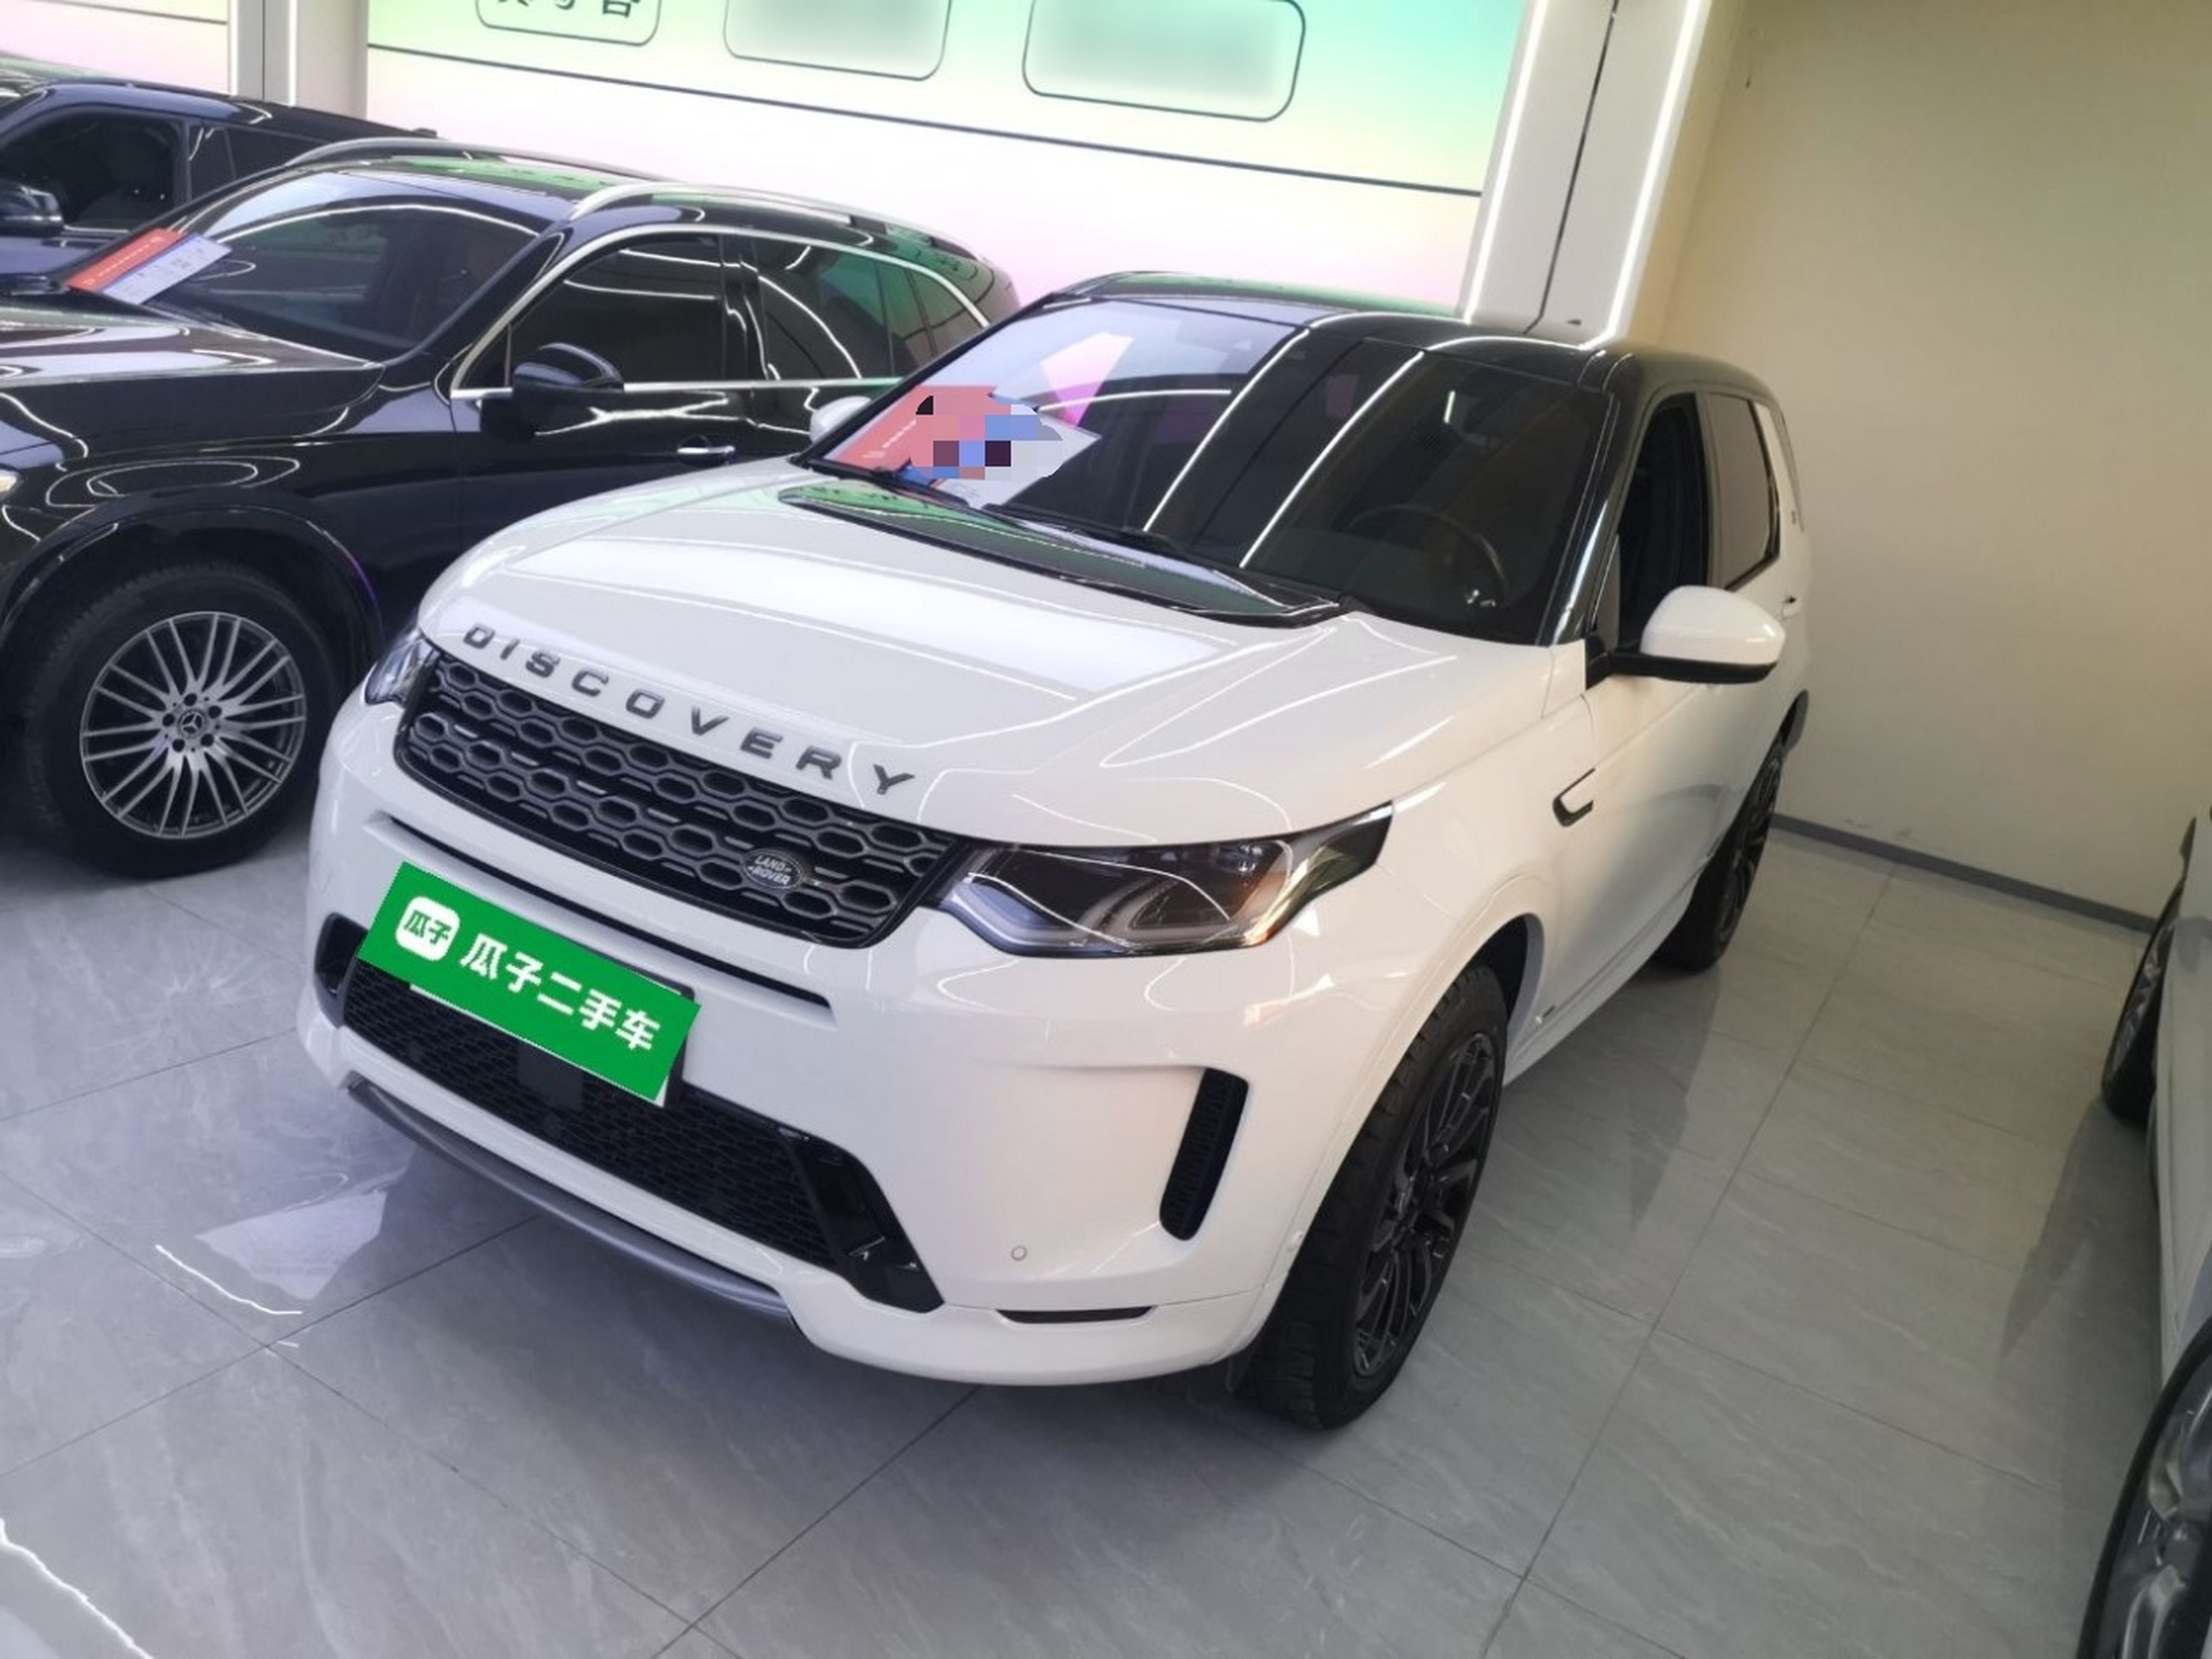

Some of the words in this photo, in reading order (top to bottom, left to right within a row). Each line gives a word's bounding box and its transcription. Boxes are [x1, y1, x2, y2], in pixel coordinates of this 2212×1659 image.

[463, 622, 915, 795] DISCOVERY
[754, 855, 786, 872] LAND
[751, 865, 791, 885] ROVER
